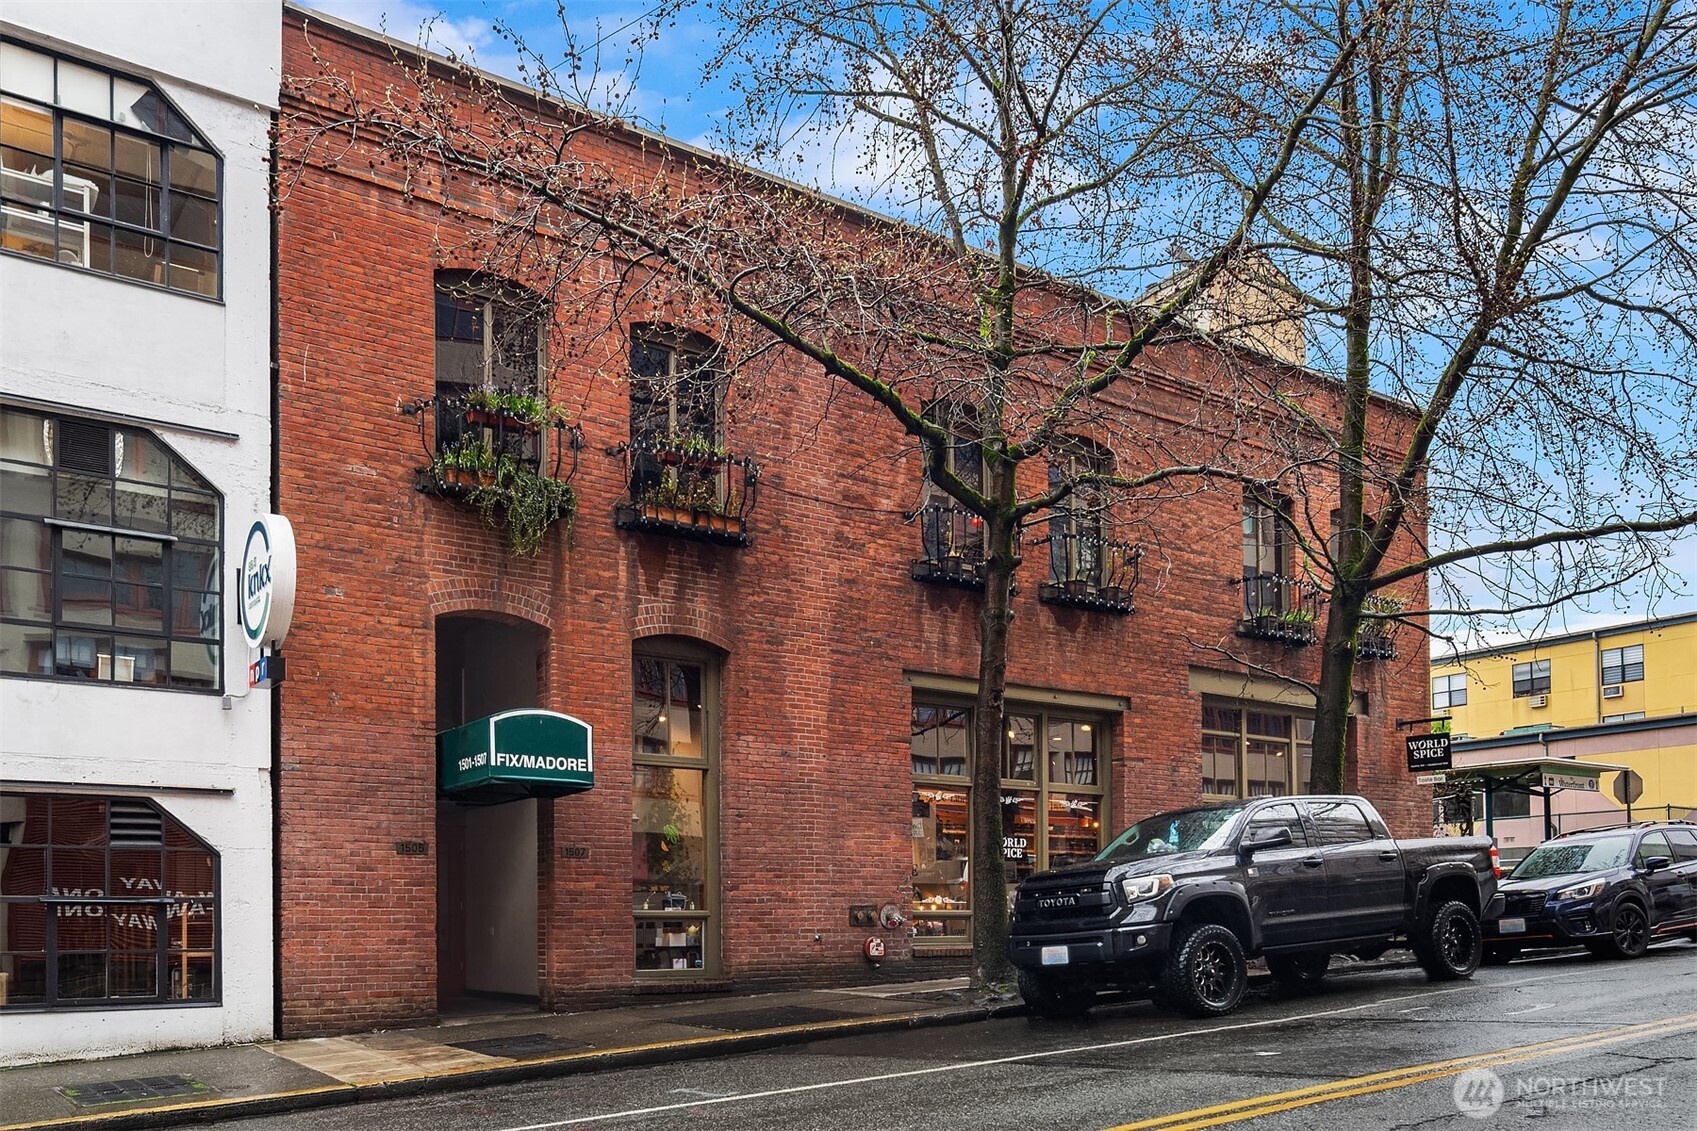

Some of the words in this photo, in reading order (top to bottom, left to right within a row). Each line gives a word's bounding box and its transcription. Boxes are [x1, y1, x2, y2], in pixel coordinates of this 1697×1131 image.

[248, 555, 272, 599] knkx
[250, 661, 266, 684] npr
[1408, 738, 1449, 750] WORLD
[1413, 748, 1444, 759] SPICE
[458, 752, 487, 771] 1501-1507
[497, 753, 587, 772] FIX/MADORE
[1003, 837, 1027, 848] RLD
[565, 847, 585, 856] 1507
[1003, 848, 1023, 858] PICE
[1039, 897, 1076, 908] TOYOTA
